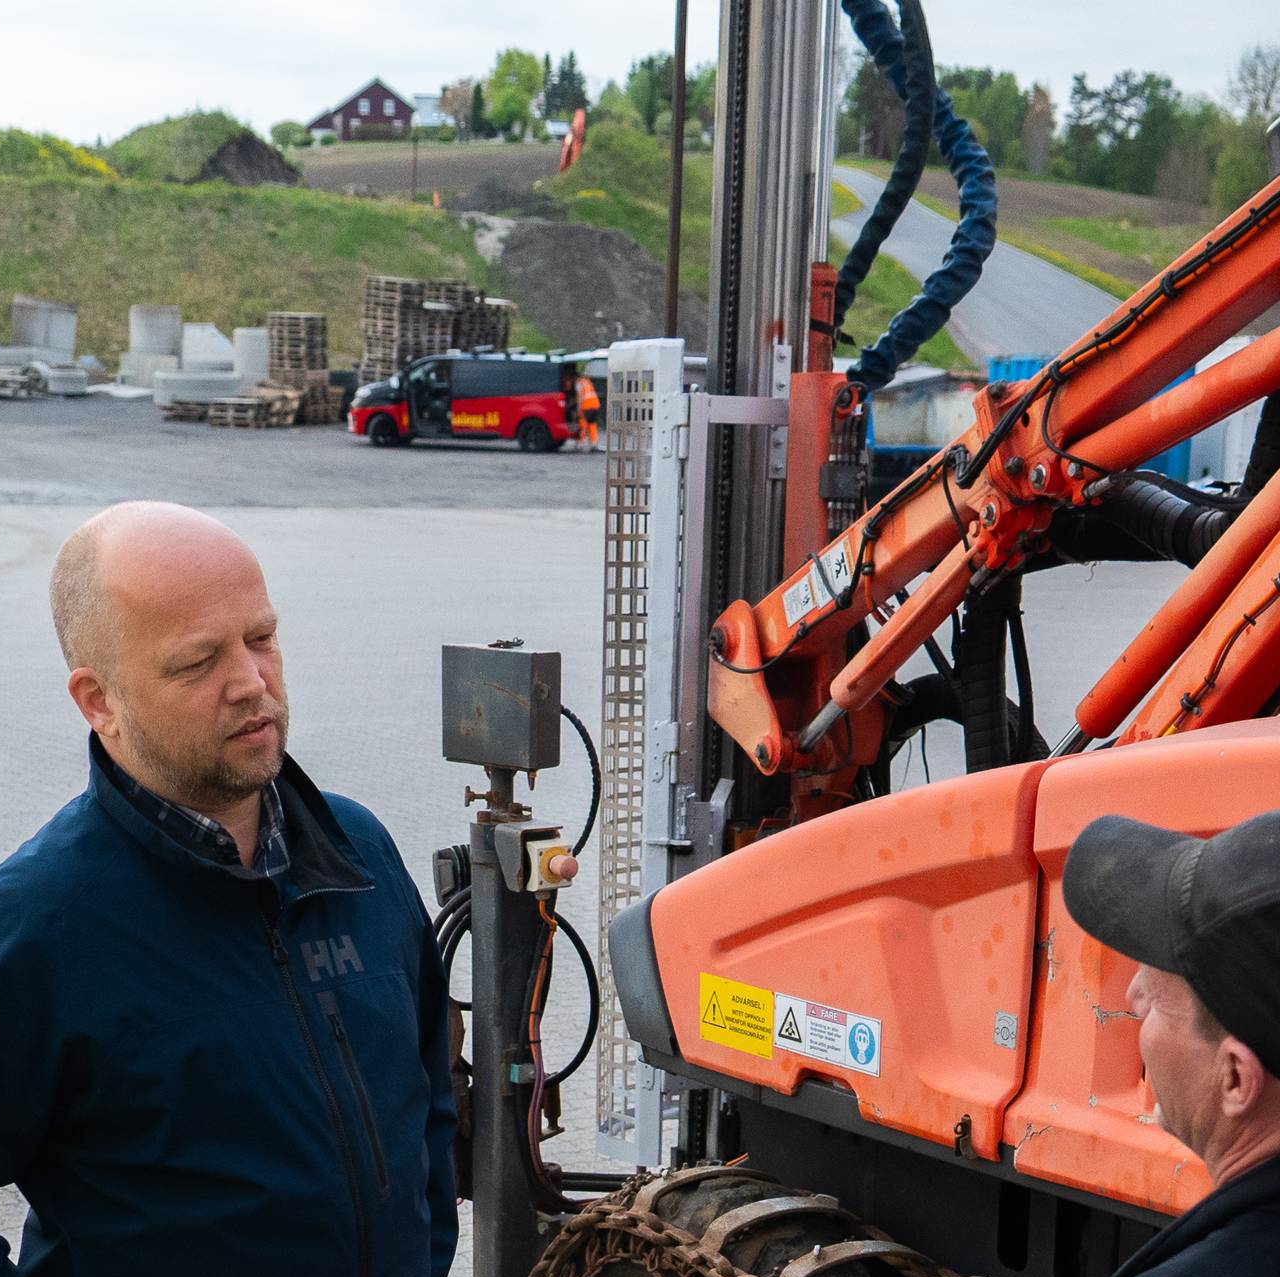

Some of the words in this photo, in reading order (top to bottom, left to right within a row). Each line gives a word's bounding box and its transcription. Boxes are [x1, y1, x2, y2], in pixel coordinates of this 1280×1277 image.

[300, 935, 365, 981] HH
[732, 994, 761, 1010] ADVARSEL
[821, 1009, 839, 1021] FARE
